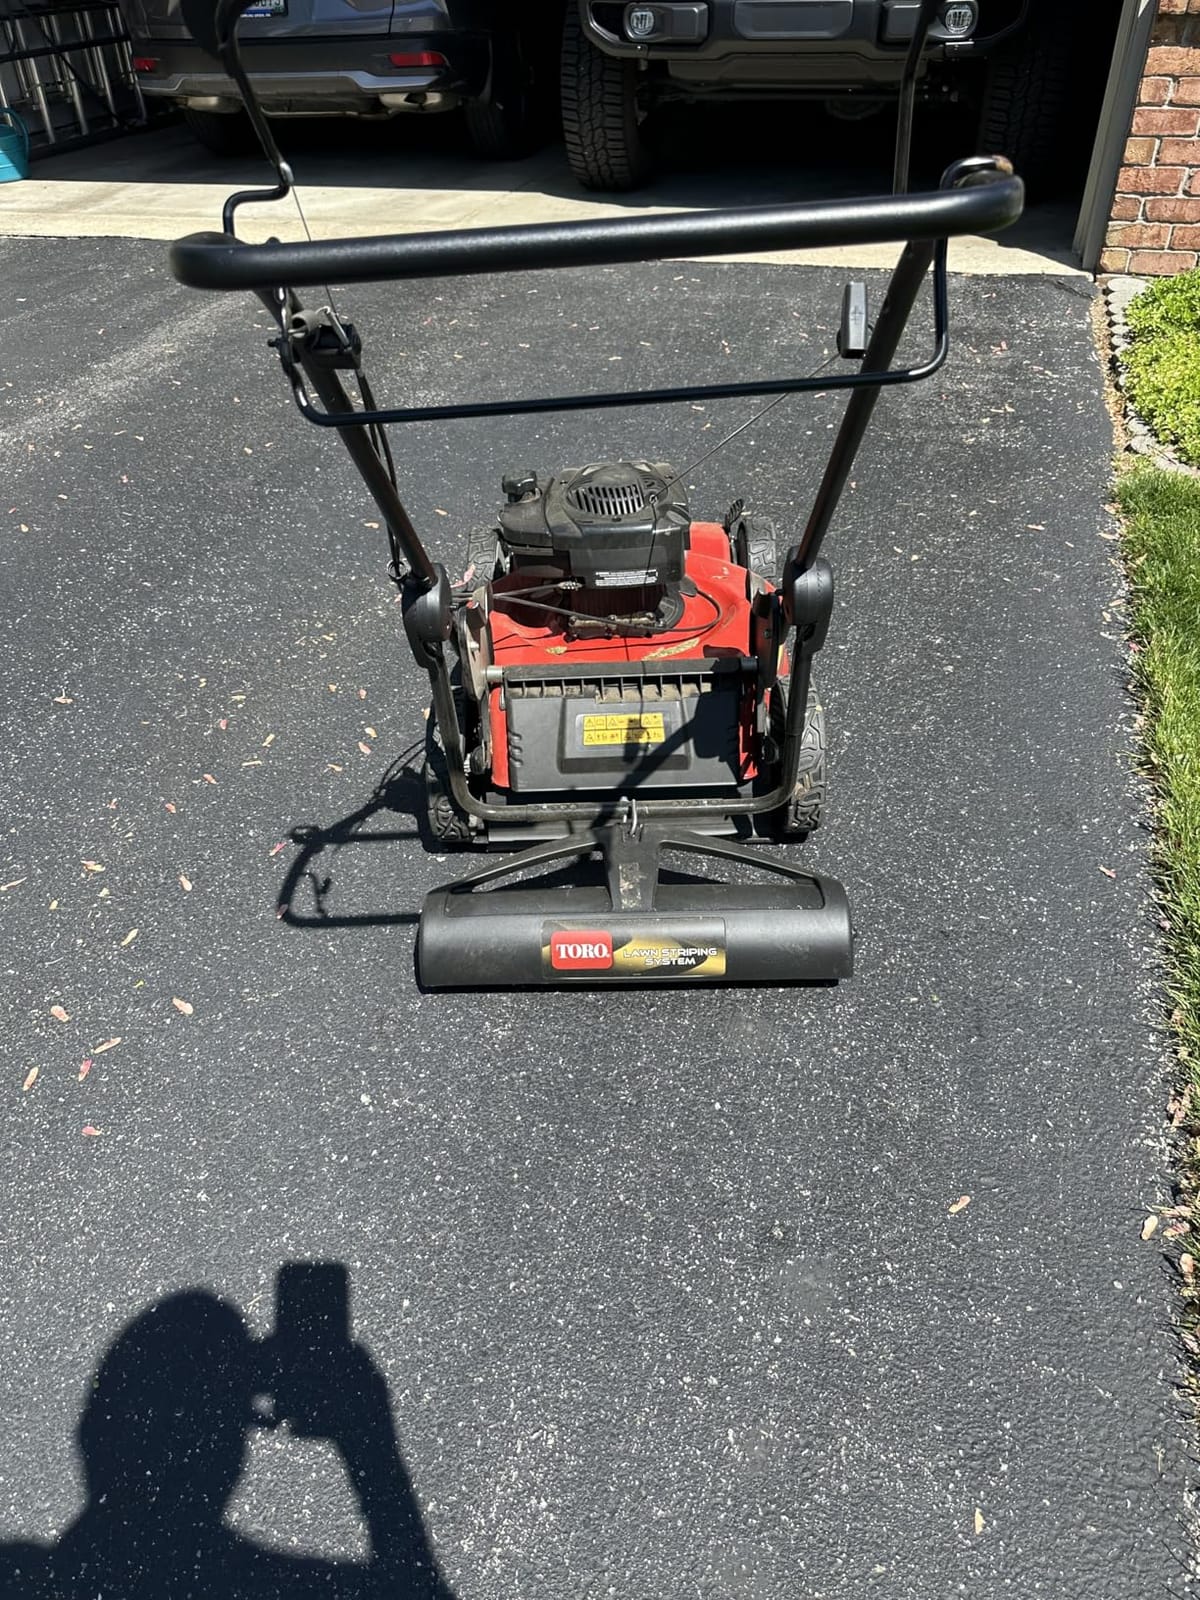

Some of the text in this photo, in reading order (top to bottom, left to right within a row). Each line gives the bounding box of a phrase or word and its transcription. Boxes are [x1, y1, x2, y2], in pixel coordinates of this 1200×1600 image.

[623, 947, 718, 958] LAWN STRIPING
[645, 957, 696, 966] SYSTEM
